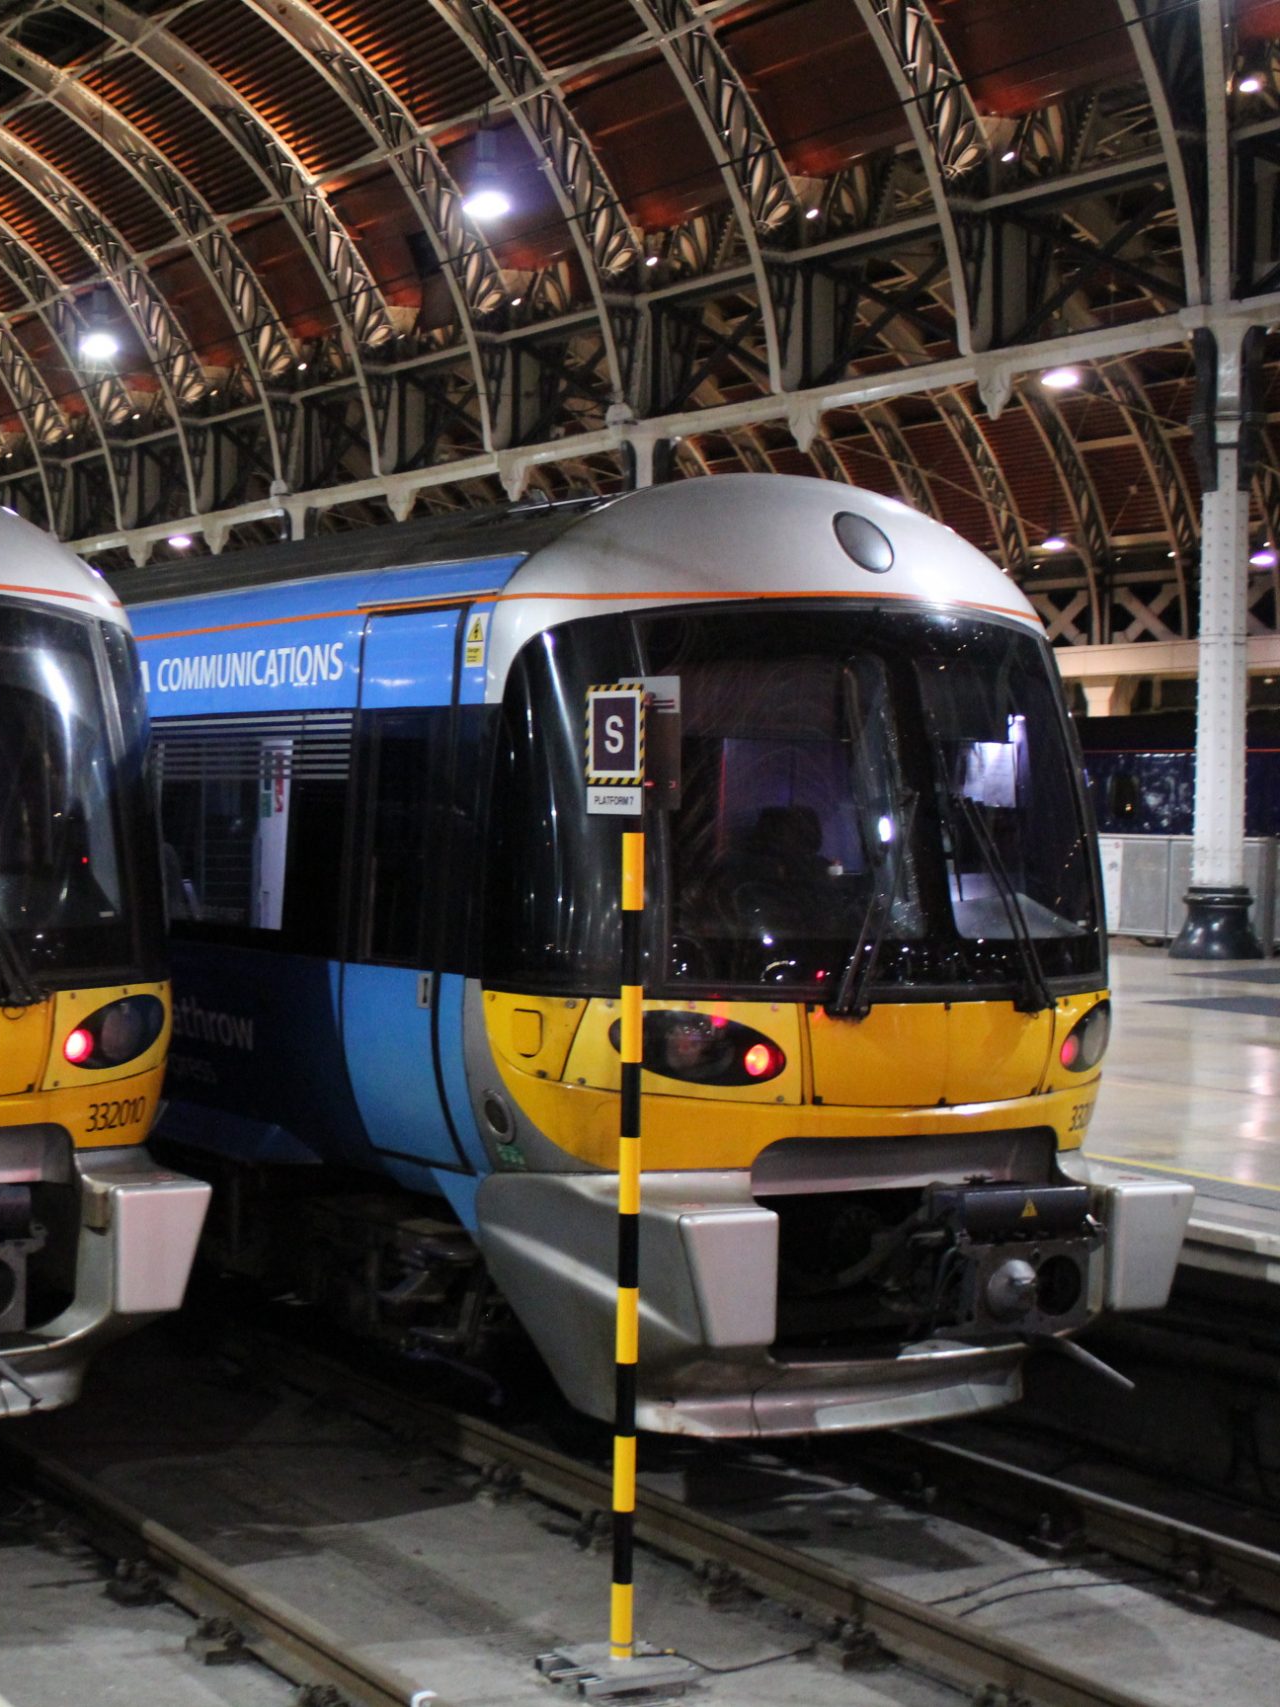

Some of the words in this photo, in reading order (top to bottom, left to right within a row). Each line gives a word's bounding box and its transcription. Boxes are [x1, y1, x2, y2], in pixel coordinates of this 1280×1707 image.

[157, 642, 344, 692] COMMUNICATIONS
[604, 714, 624, 754] S
[593, 795, 628, 806] PLATFORM
[85, 1096, 146, 1132] 332010
